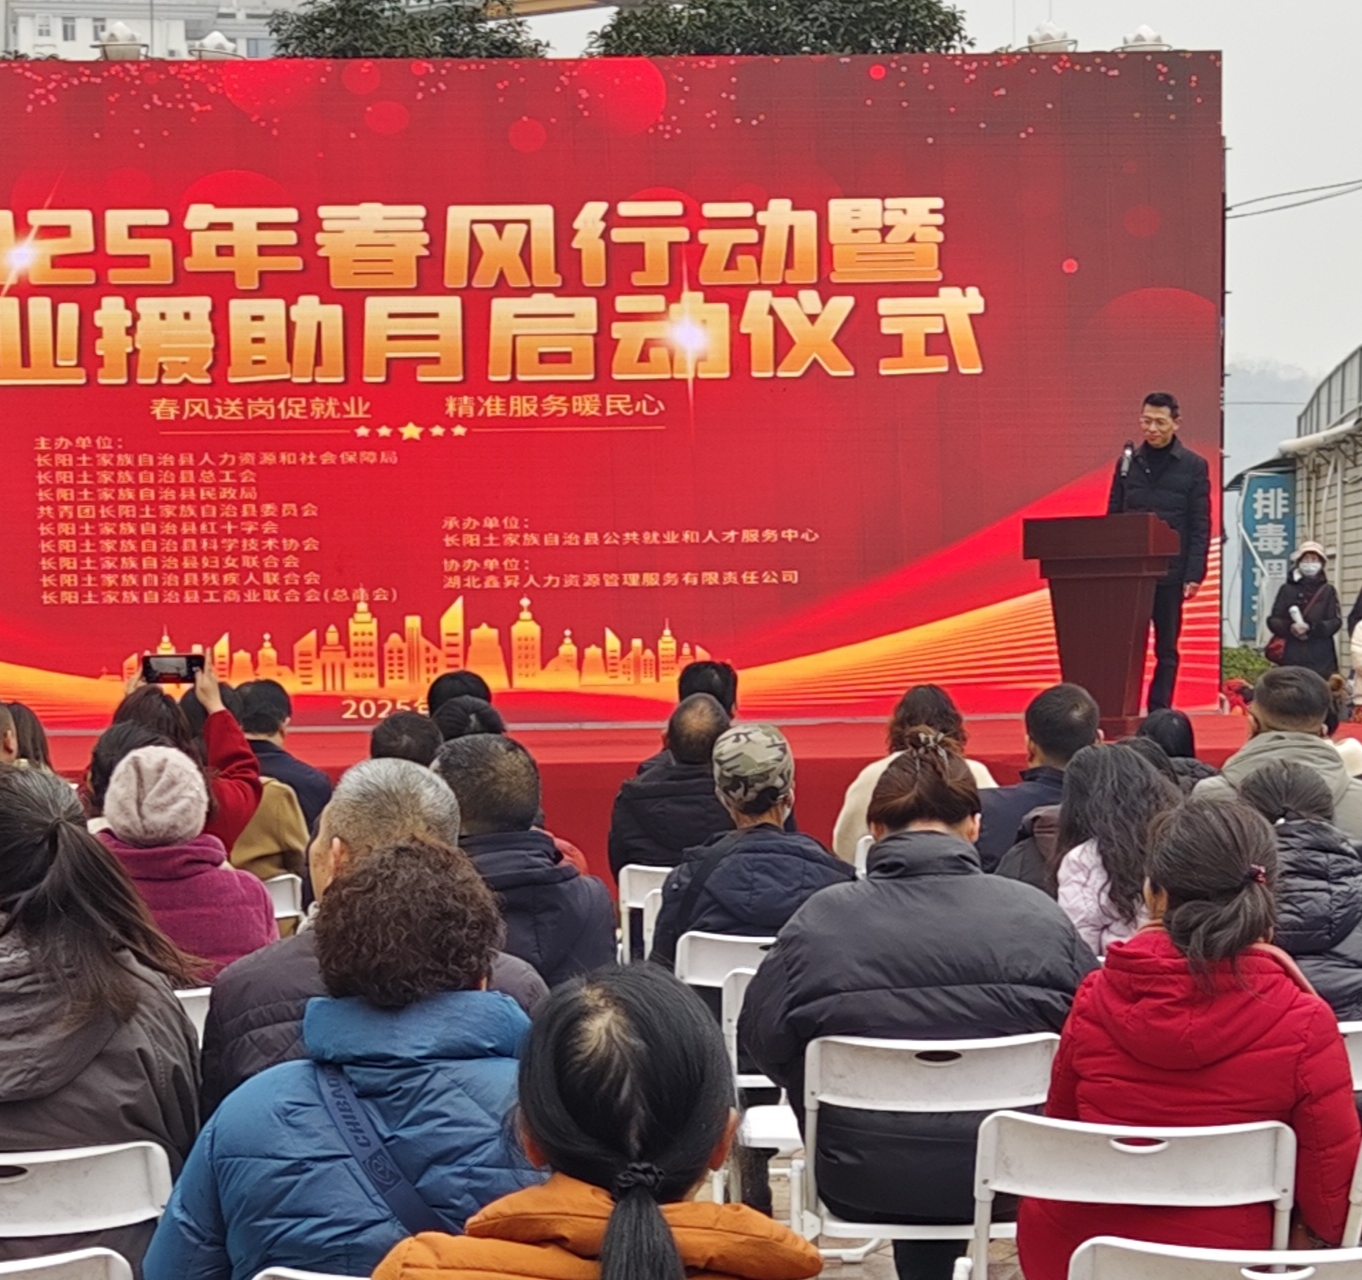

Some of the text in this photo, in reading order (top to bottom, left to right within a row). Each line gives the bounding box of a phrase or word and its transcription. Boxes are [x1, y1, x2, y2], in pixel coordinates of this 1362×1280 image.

[149, 393, 666, 422] 春风送岗促就业 精准服务暖民心
[33, 436, 124, 451] 主办单位：
[34, 451, 398, 468] 长阳土家族自治县人力资源和社会保障局
[35, 468, 258, 485] 长阳土家族自治县总工会
[36, 486, 258, 502] 长阳土家族自治县民政局
[37, 503, 319, 519] 共青团长阳土家族自治县委员会
[38, 519, 280, 536] 长阳土家族自治县红十字会
[442, 515, 530, 531] 承办单位：
[39, 536, 321, 553] 长阳土家族自治县科学技术协会
[442, 527, 820, 548] 长阳土家族自治县公共就业和人才服务中心
[40, 554, 301, 570] 长阳土家族自治县妇女联合会
[442, 557, 530, 573] 协办单位：
[40, 570, 322, 588] 长阳土家族自治县残疾人联合会
